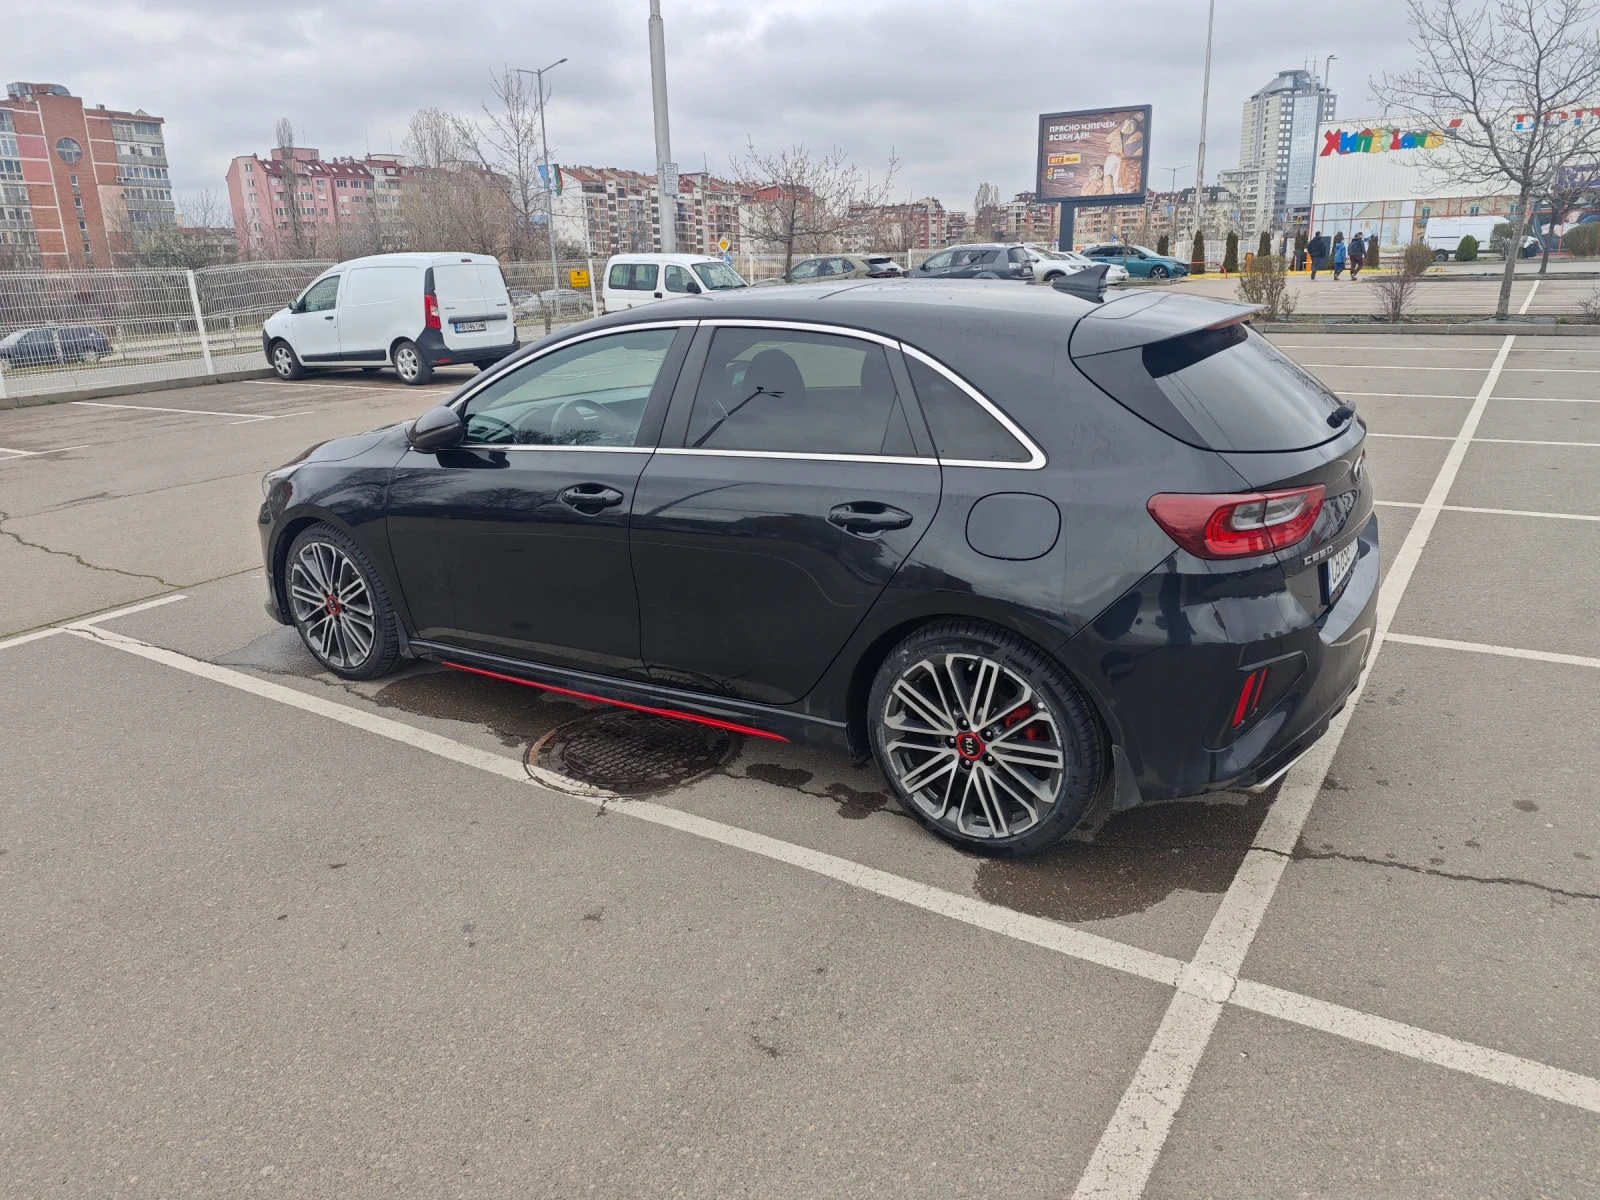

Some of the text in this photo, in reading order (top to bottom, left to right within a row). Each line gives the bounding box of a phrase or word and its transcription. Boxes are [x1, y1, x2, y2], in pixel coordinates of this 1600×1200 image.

[1049, 121, 1117, 133] ПРЯСНО ИЗПЕЧЕН.
[1049, 132, 1092, 142] ВСЕКИ ДЕН.
[1303, 545, 1333, 566] CEED
[965, 737, 974, 755] KIA
